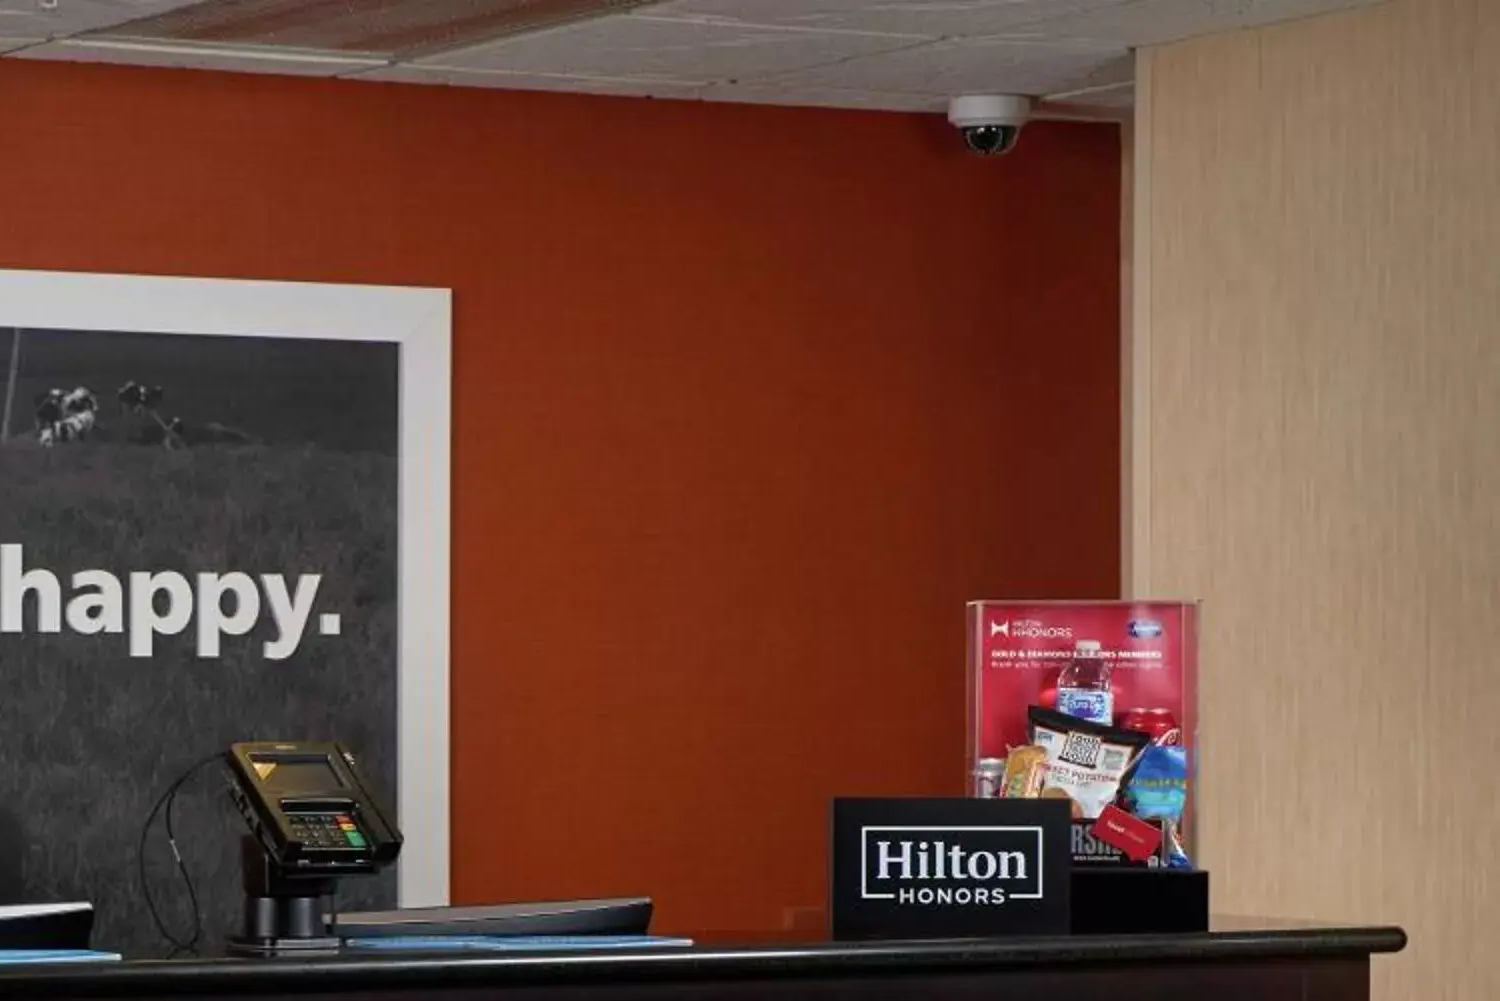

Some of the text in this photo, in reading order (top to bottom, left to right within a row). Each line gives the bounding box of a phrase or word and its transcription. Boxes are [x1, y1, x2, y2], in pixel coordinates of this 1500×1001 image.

[0, 543, 341, 660] happy.
[876, 841, 1028, 880] Hilton
[899, 887, 1006, 905] HONORS
